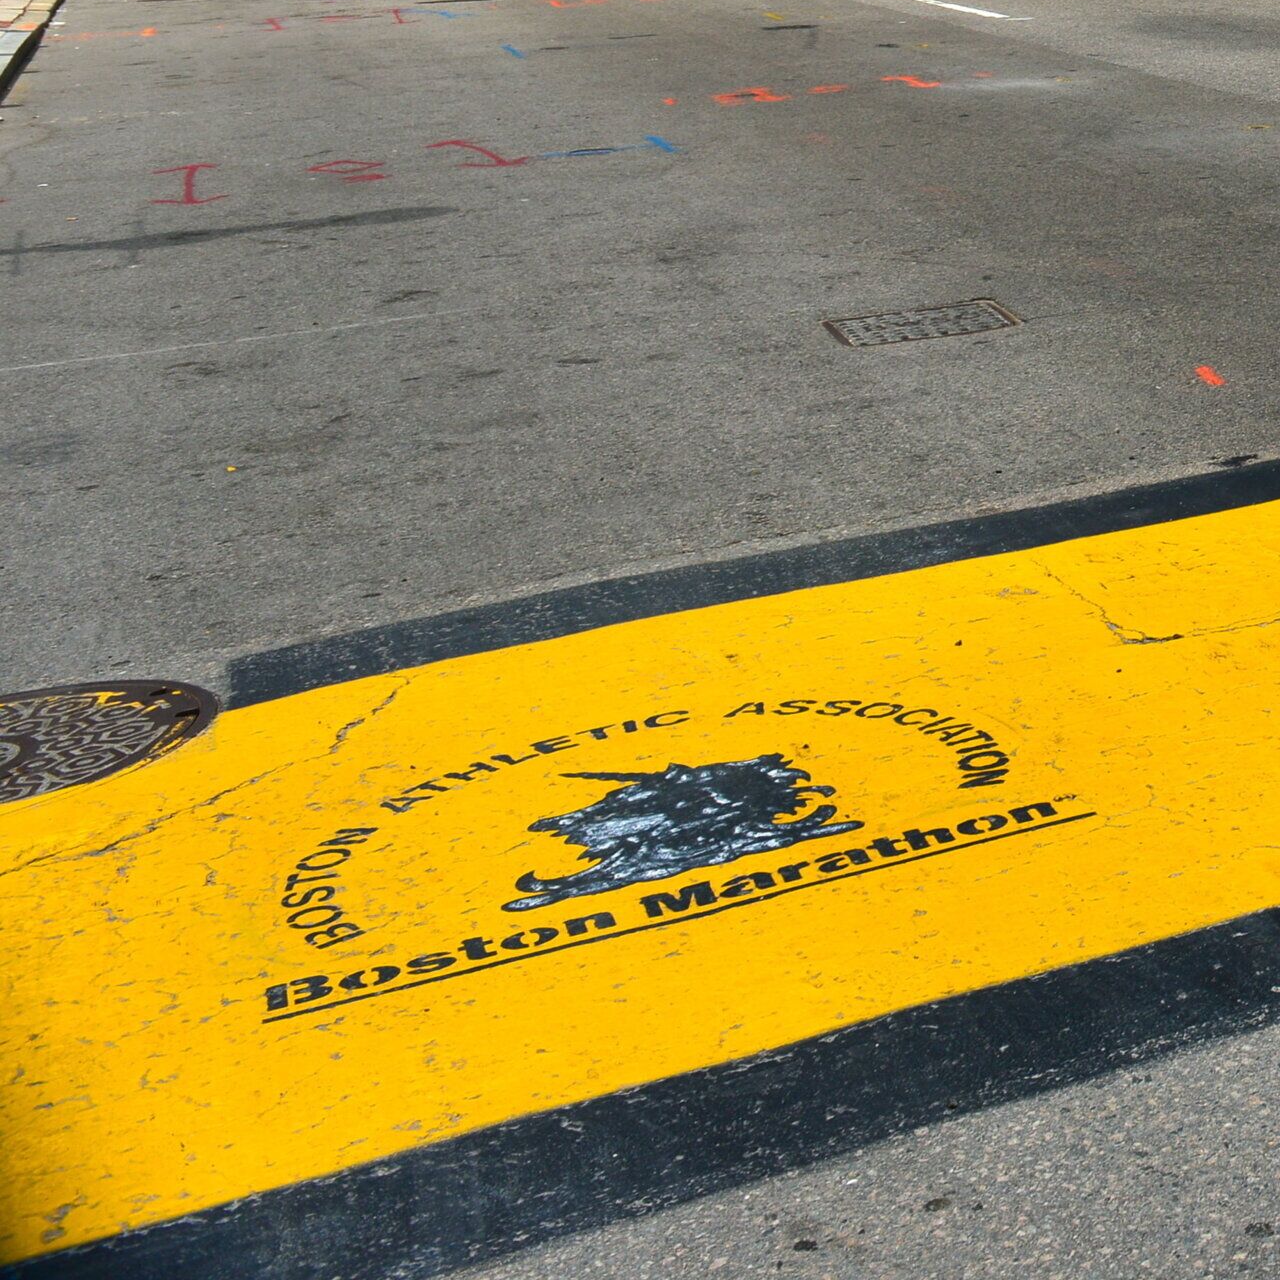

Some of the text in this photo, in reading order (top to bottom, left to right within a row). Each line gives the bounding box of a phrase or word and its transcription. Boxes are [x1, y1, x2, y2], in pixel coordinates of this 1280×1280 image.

[264, 801, 1060, 1012] Boston Marathon
[281, 700, 1011, 949] BOSTON ATHLETIC ASSOCIATION
